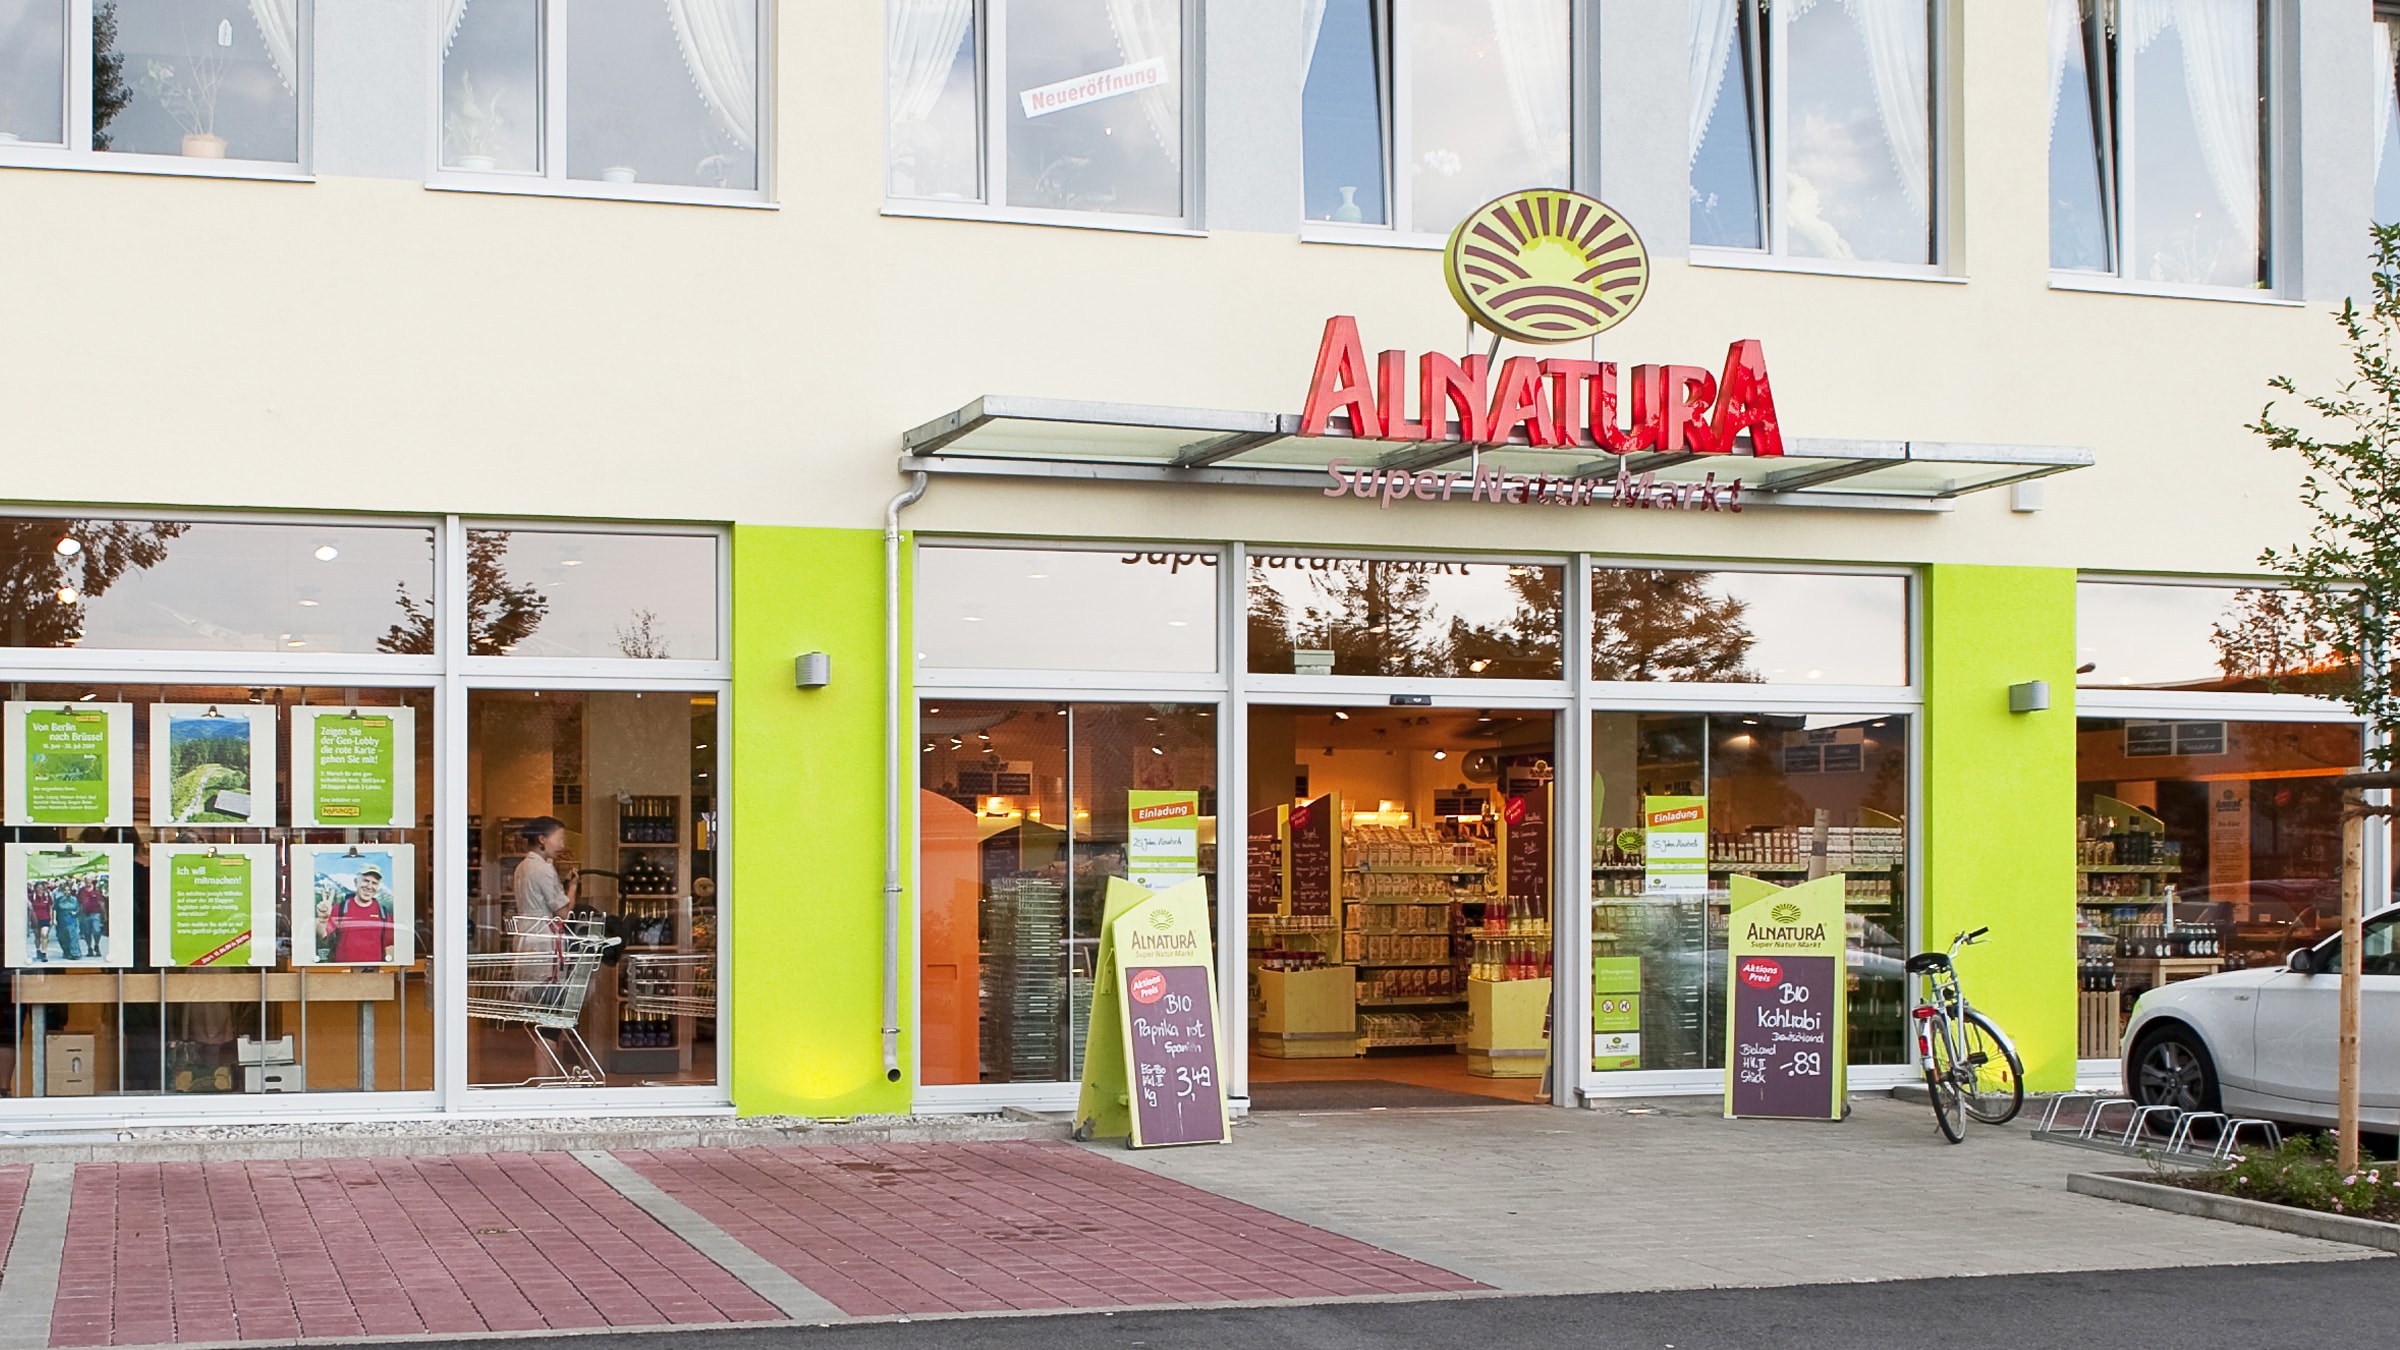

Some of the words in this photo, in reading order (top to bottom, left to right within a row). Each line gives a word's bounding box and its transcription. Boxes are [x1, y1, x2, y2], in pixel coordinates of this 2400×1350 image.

[1031, 67, 1158, 110] Neueröffnung
[1301, 315, 1785, 459] ALNATURA
[1323, 457, 1462, 510] Super
[1472, 464, 1603, 507] Natur
[1612, 469, 1743, 514] Markt
[32, 722, 49, 732] Von
[51, 722, 76, 732] Berlin
[320, 727, 348, 738] Zeigen
[349, 727, 362, 736] Sie
[50, 732, 70, 741] nach
[72, 732, 104, 742] Brüssel
[320, 736, 334, 744] der
[336, 736, 380, 747] Gen-Lobby
[320, 746, 333, 754] die
[354, 746, 376, 754] Karte
[320, 755, 346, 766] gehen
[348, 755, 360, 764] Sie
[362, 755, 378, 764] mit!
[1138, 805, 1188, 820] Einladung
[1654, 809, 1698, 823] Einladung
[176, 866, 189, 875] Ich
[192, 866, 206, 875] will
[194, 876, 242, 884] mitmachen!
[1746, 922, 1826, 941] ALNATURA
[1132, 930, 1198, 950] ALNATURA
[1751, 941, 1772, 949] Super
[1136, 950, 1154, 958] Super
[1743, 964, 1778, 974] Aktions
[1133, 975, 1161, 990] Aktions
[1748, 972, 1771, 982] Preis
[1140, 986, 1158, 998] Preis
[1778, 982, 1810, 1004] BIO
[1163, 993, 1192, 1014] BIO
[1134, 1018, 1180, 1046] Paprika
